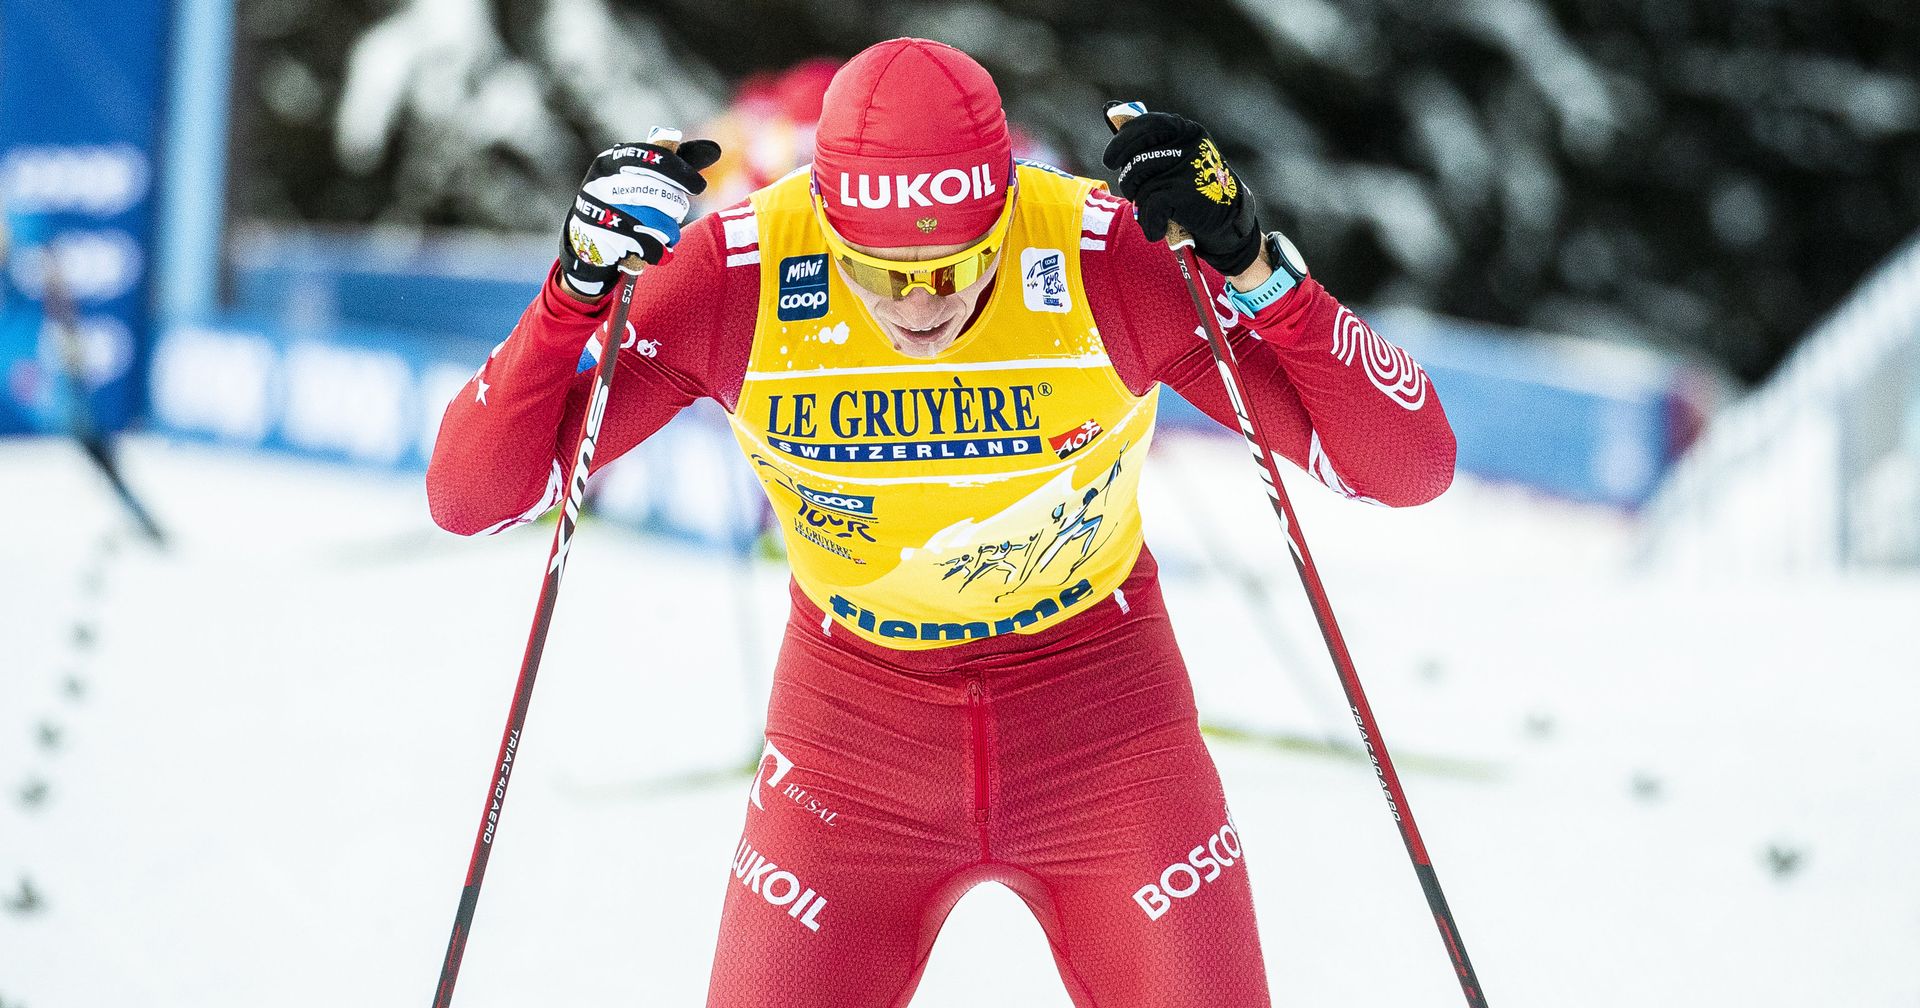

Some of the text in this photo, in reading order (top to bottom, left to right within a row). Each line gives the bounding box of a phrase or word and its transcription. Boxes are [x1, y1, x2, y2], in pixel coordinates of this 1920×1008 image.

[1132, 149, 1182, 166] Alexander
[612, 185, 659, 196] Alexander
[839, 162, 997, 210] LUKOIL
[1178, 259, 1192, 280] TCS
[621, 284, 635, 304] TCS
[780, 291, 827, 310] coop
[766, 394, 818, 439] LE
[778, 439, 1031, 461] SWITZERLAND
[1054, 425, 1101, 456] AOP
[797, 498, 877, 543] TOUR
[803, 490, 864, 510] coop
[829, 578, 1094, 641] fiemme
[501, 729, 520, 776] TRIAC
[1350, 705, 1374, 752] TRIAC
[1378, 777, 1401, 822] AERO
[483, 798, 500, 845] AERO
[783, 782, 840, 827] RUSAL
[732, 837, 828, 933] LUKOIL
[1132, 824, 1242, 922] BOSCO
